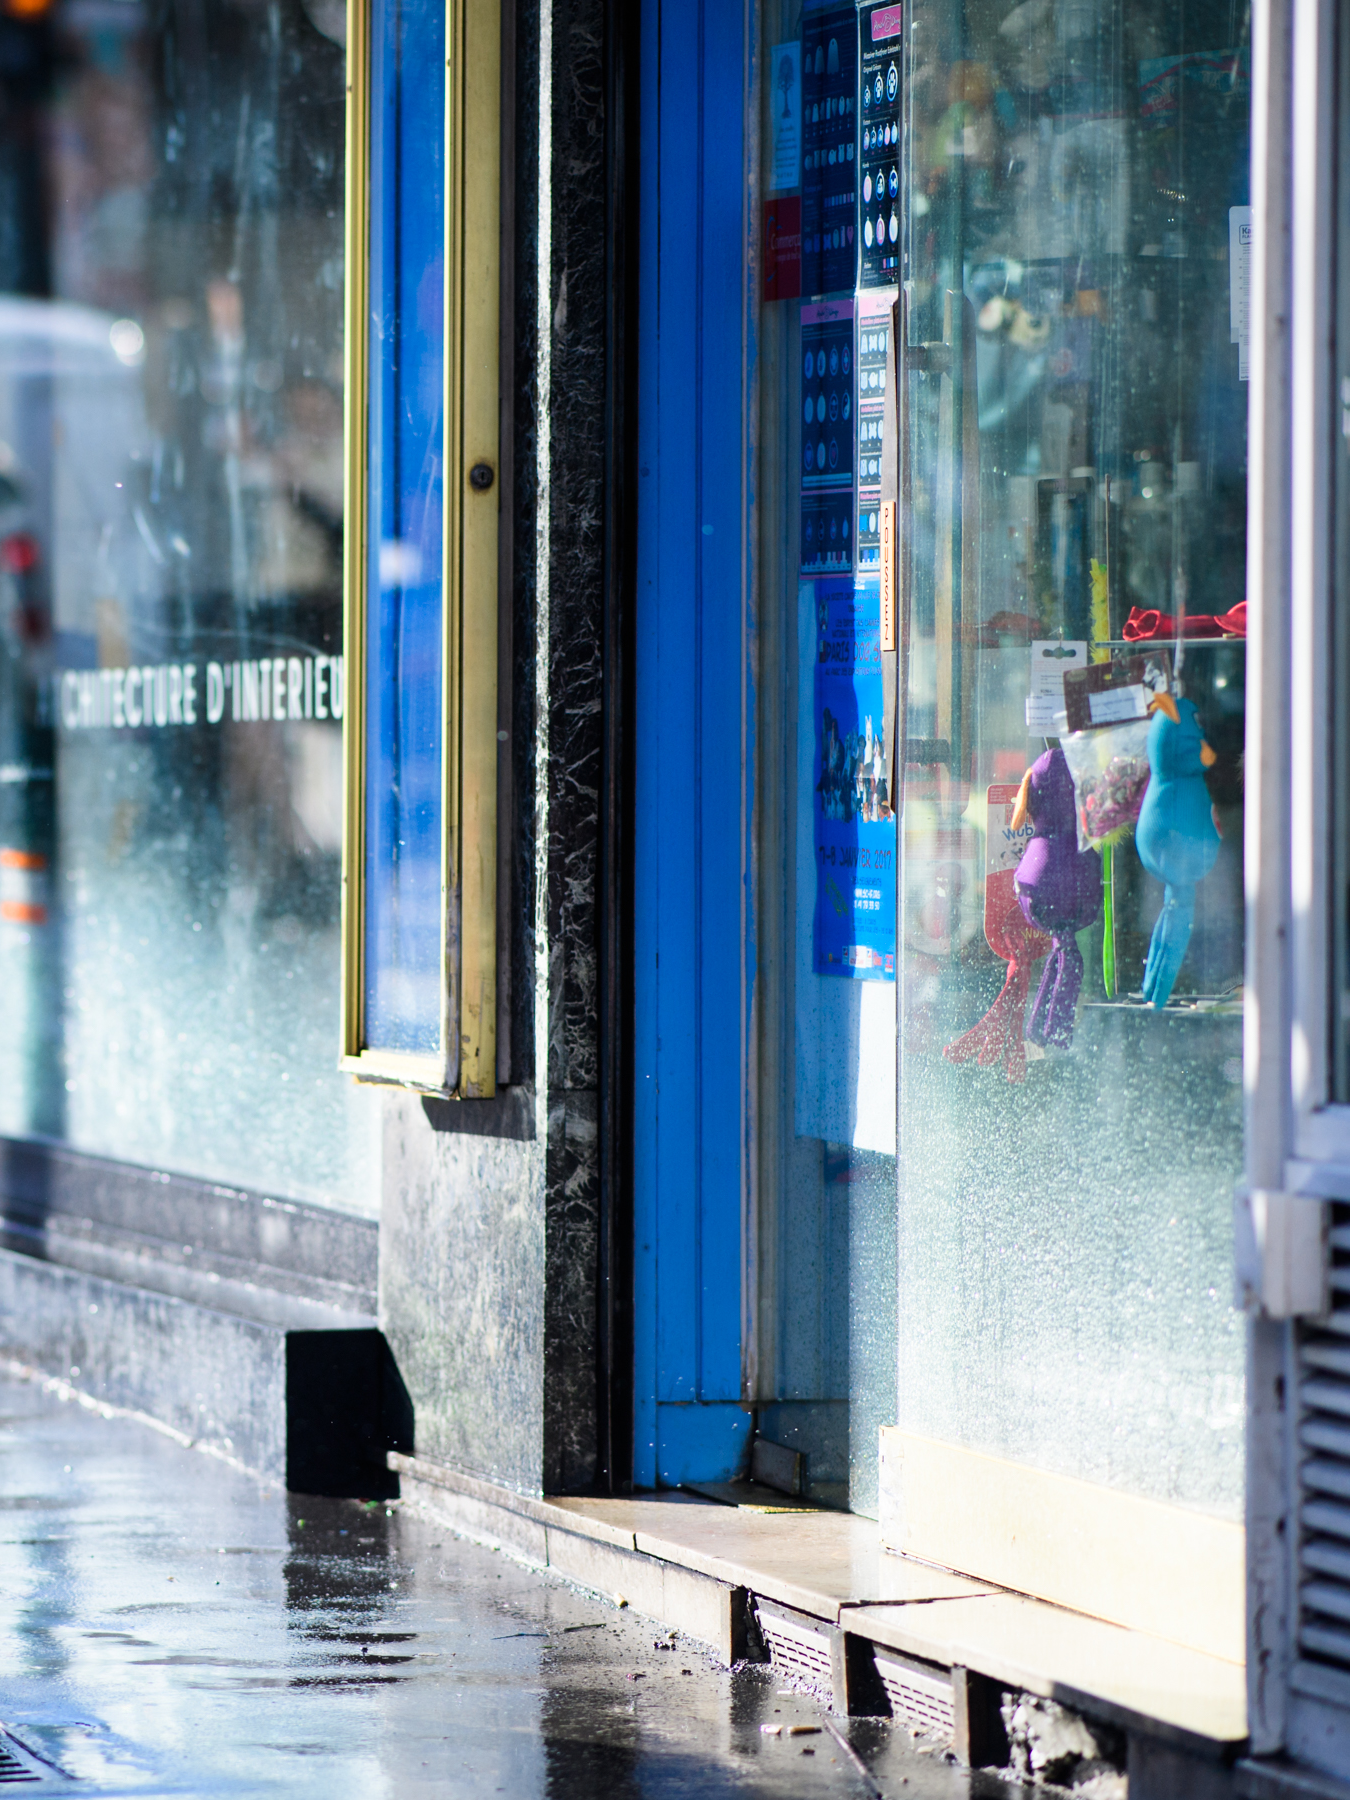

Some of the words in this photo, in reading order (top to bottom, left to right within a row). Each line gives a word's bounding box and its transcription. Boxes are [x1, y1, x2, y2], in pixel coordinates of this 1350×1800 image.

[853, 641, 870, 662] DOG
[36, 664, 198, 730] CHITECTURE
[839, 846, 871, 868] JANVIER
[874, 848, 892, 870] 2017
